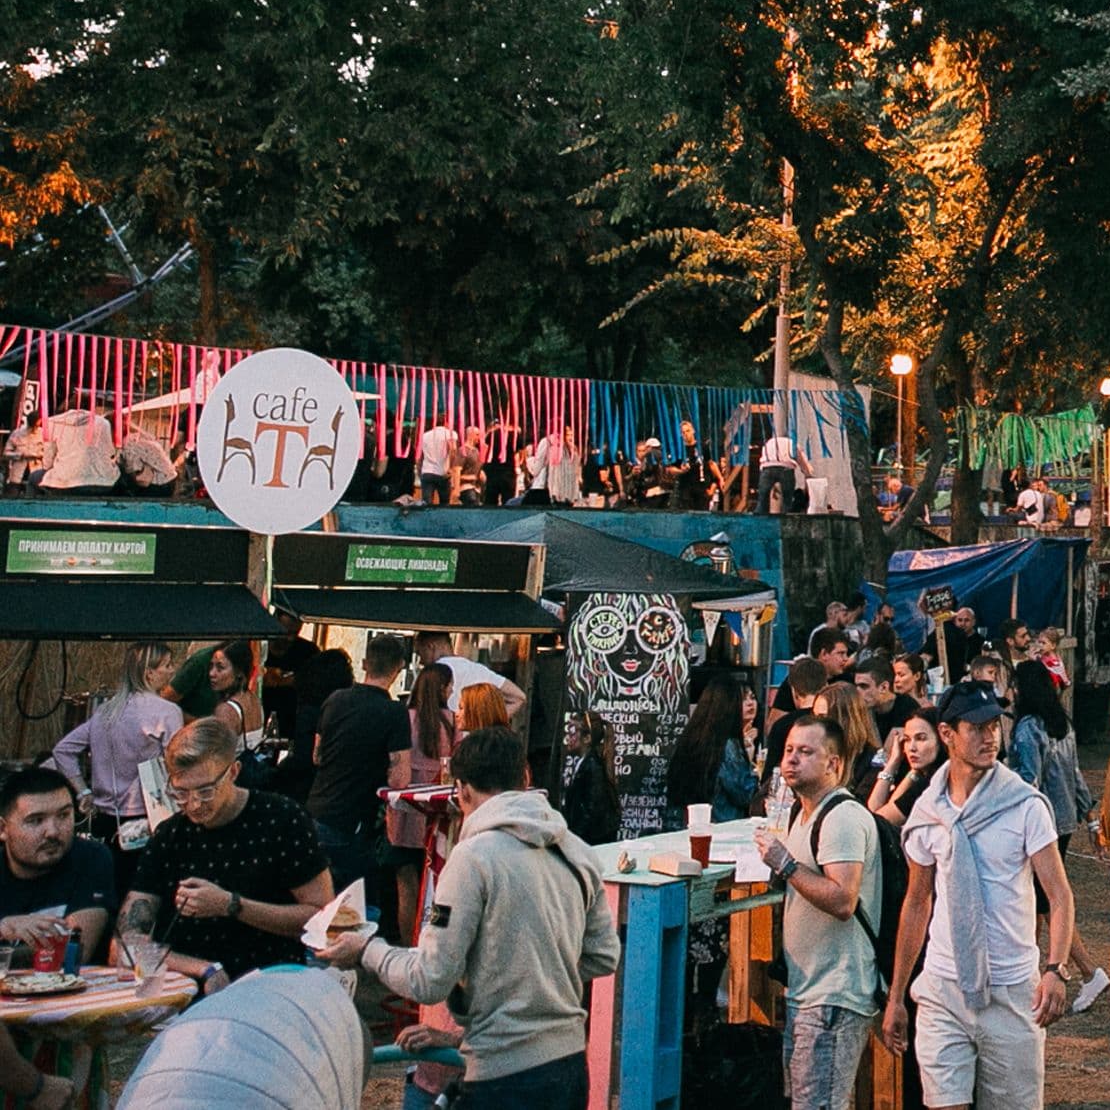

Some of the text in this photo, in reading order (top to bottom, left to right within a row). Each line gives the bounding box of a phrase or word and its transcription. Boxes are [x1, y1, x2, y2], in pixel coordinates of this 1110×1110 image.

[253, 387, 318, 424] cafe
[18, 540, 146, 555] ПРИНИМАЕМ ОПЛАТУ КАРТОЙ
[355, 557, 449, 572] ОСВЕЖАЮЩИЕ ЛИМОНАДЫ
